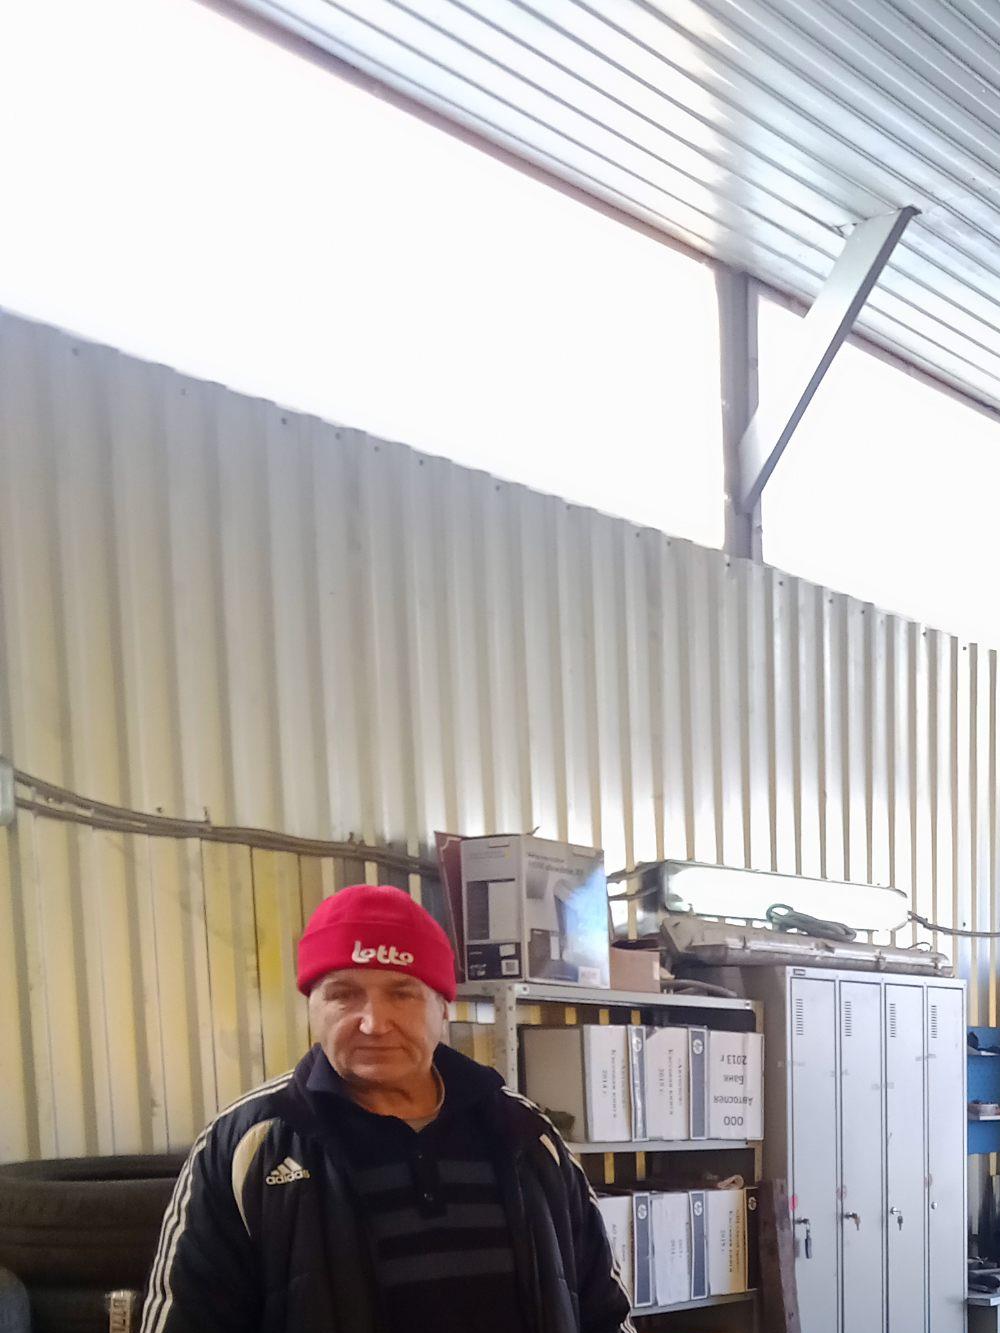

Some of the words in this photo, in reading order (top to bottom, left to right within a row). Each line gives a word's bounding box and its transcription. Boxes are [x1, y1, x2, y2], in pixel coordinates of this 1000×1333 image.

[726, 1055, 747, 1065] 2013
[723, 1074, 744, 1085] Банк
[723, 1115, 744, 1126] ООО
[265, 1169, 310, 1185] adidas
